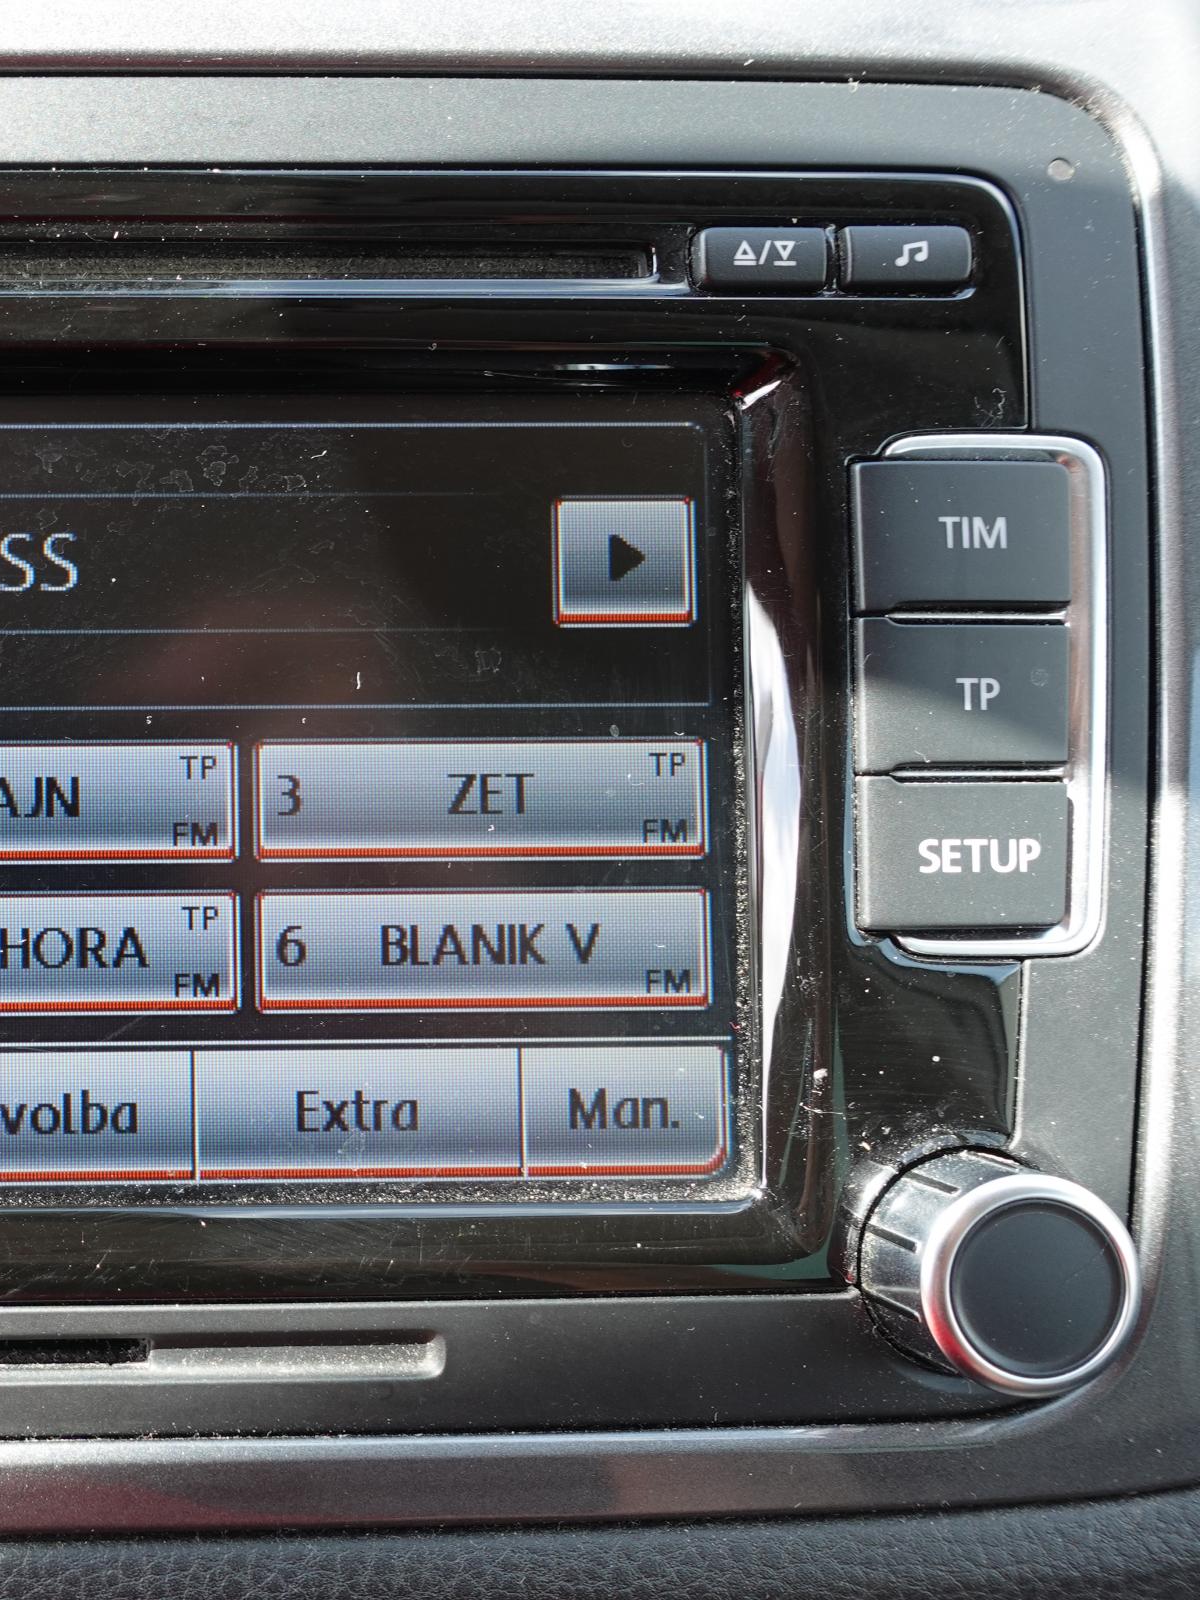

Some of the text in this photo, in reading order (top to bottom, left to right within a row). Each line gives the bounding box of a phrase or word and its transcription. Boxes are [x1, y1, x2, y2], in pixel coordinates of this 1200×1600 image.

[939, 516, 1008, 550] TIM
[956, 677, 1000, 711] TP
[180, 756, 217, 779] TP
[648, 753, 686, 776] TP
[277, 774, 534, 816] 3 ZET
[172, 822, 218, 846] FM
[642, 819, 688, 843] FM
[918, 838, 1042, 874] SETUP
[181, 907, 219, 930] TP
[276, 923, 600, 966] 6 BLANIK V
[174, 974, 220, 998] FM
[645, 969, 691, 994] FM
[296, 1090, 420, 1133] Extra
[568, 1088, 680, 1130] Man.
